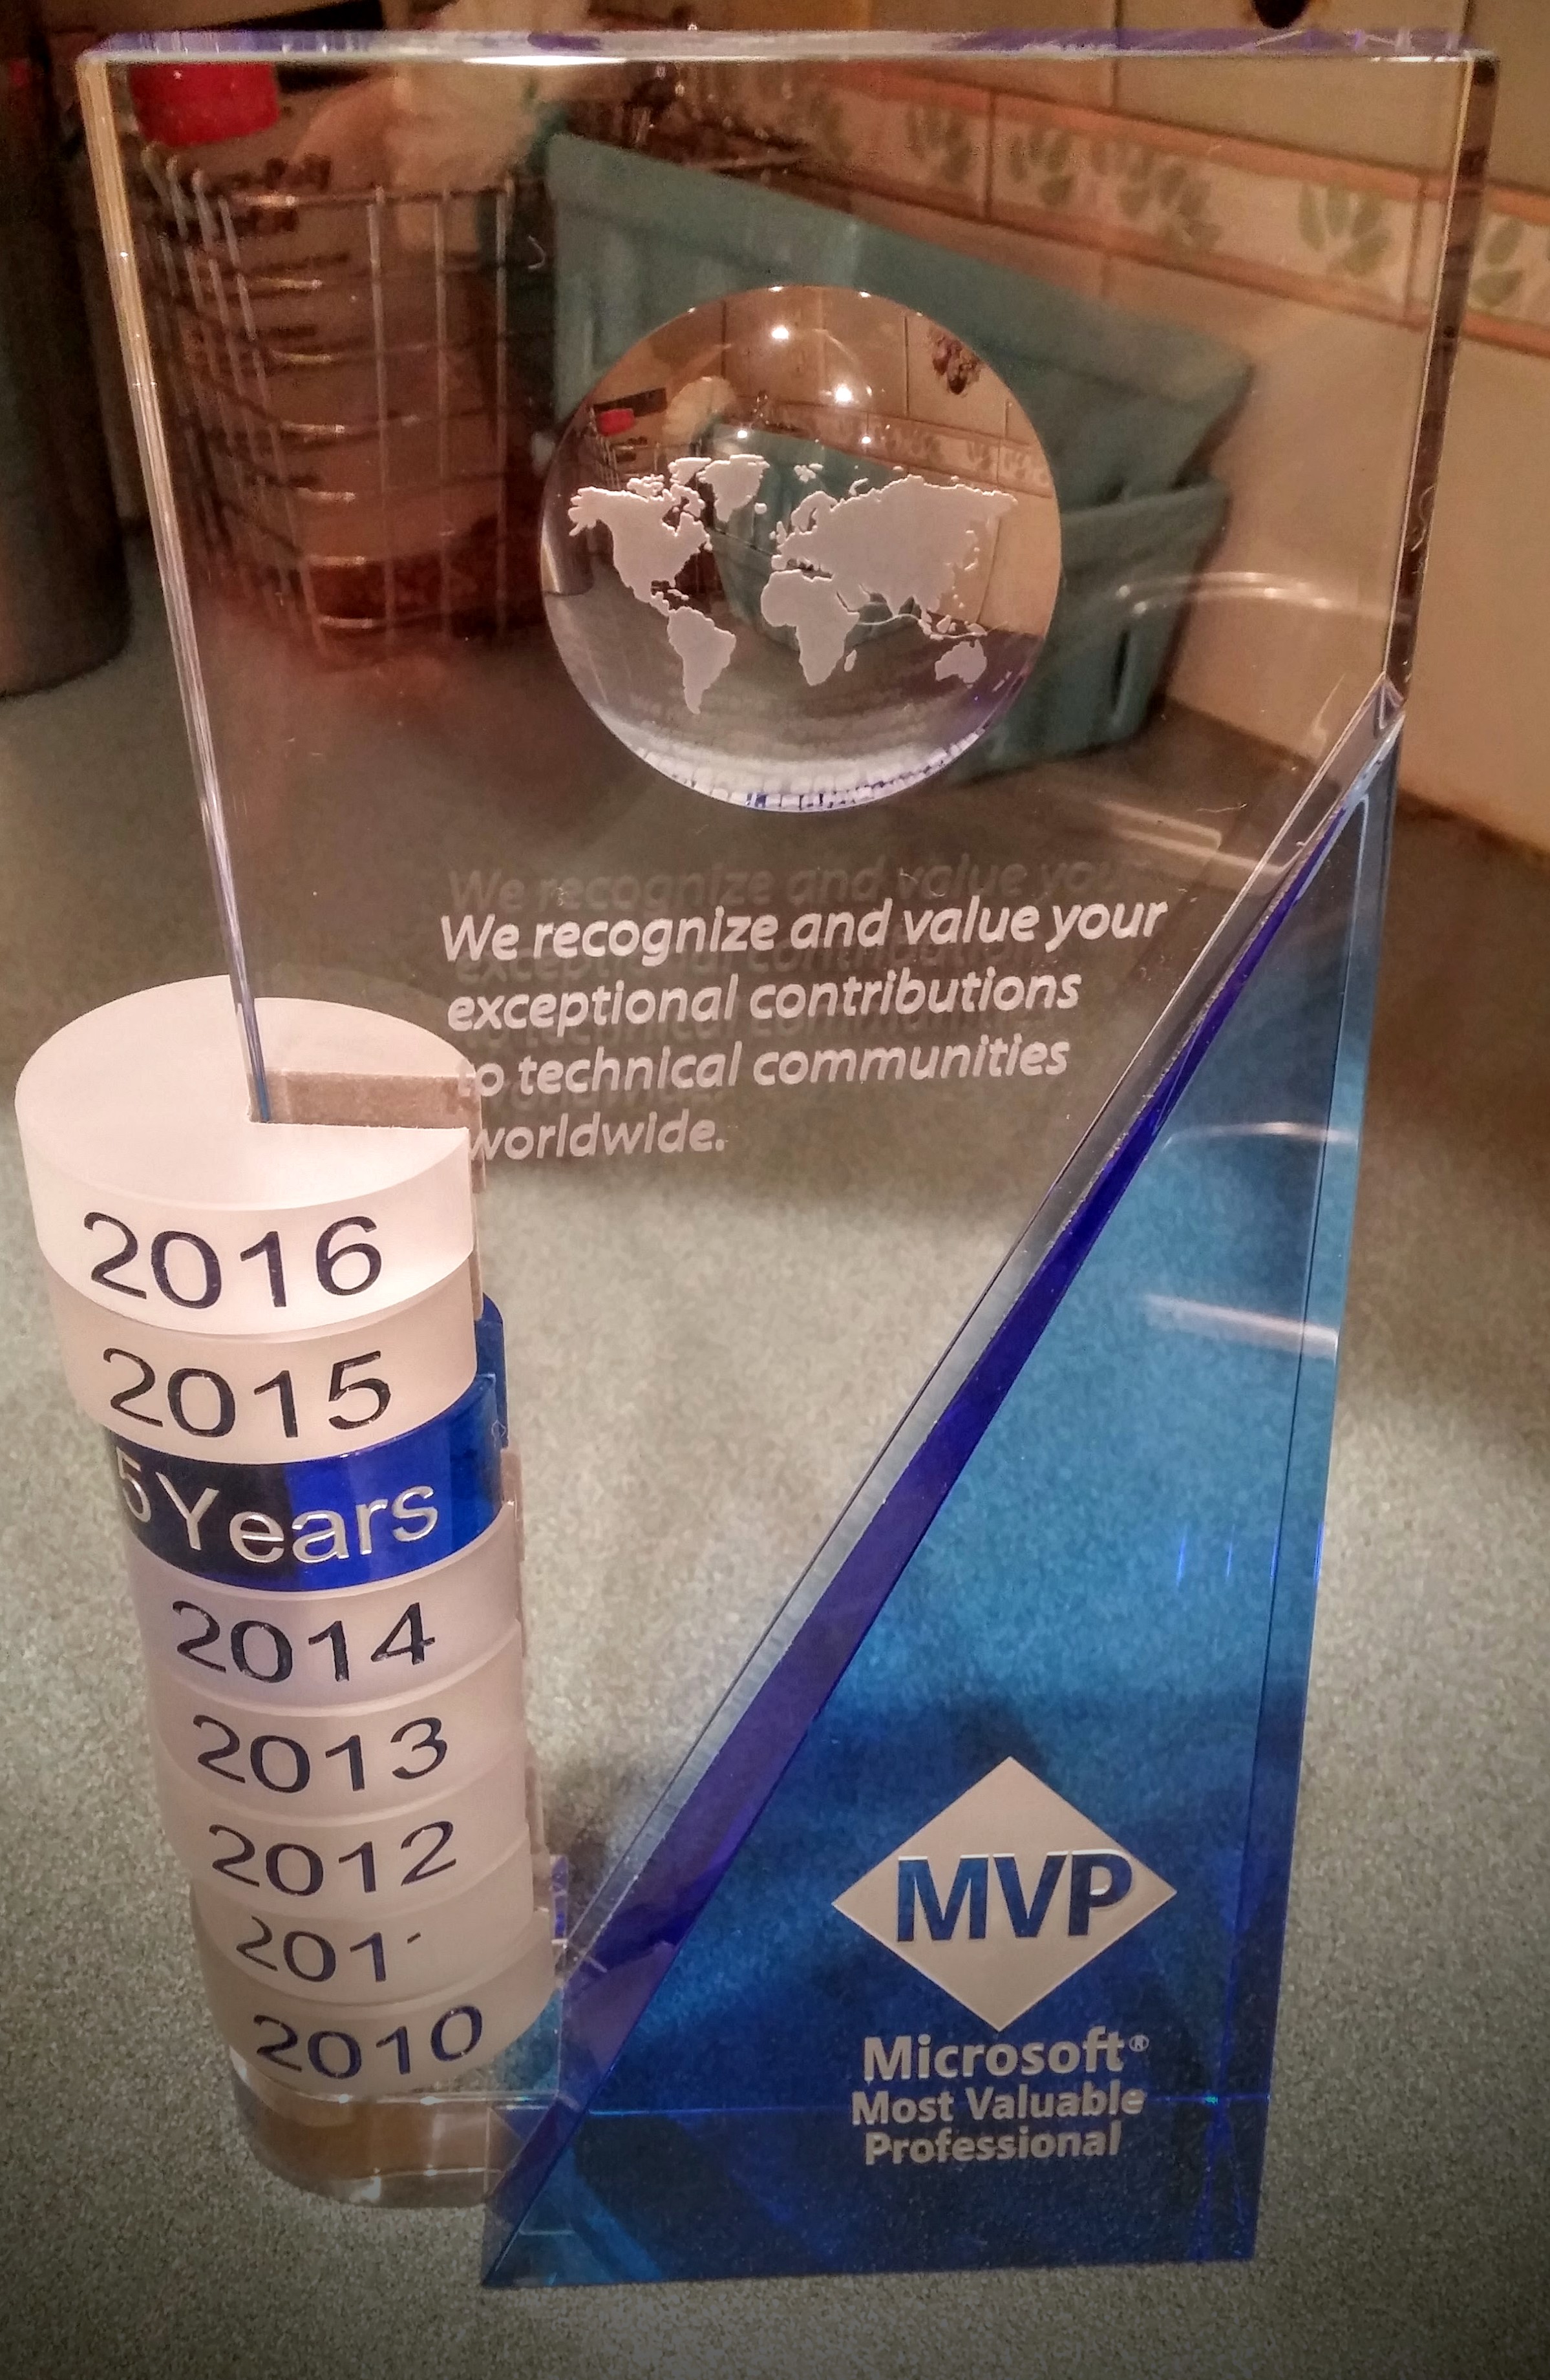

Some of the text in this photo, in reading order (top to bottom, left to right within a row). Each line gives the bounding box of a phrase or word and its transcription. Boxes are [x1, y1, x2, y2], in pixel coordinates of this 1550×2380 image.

[441, 895, 1169, 967] We recognize and value your
[447, 967, 1081, 1038] exceptional contributions
[518, 1040, 743, 1095] technical
[752, 1033, 1070, 1086] communities
[469, 1108, 725, 1161] worldwide.
[83, 1212, 383, 1309] 2016
[102, 1347, 392, 1438] 2015
[155, 1471, 438, 1563] Years
[171, 1599, 436, 1683] 2014
[192, 1714, 449, 1794] 2013
[208, 1820, 457, 1897] 2012
[897, 1848, 1133, 1942] MVP
[236, 1915, 421, 1983] 201
[253, 2004, 483, 2080] 2010
[851, 2079, 1147, 2126] Most Valuable
[864, 2120, 1122, 2166] Professional
